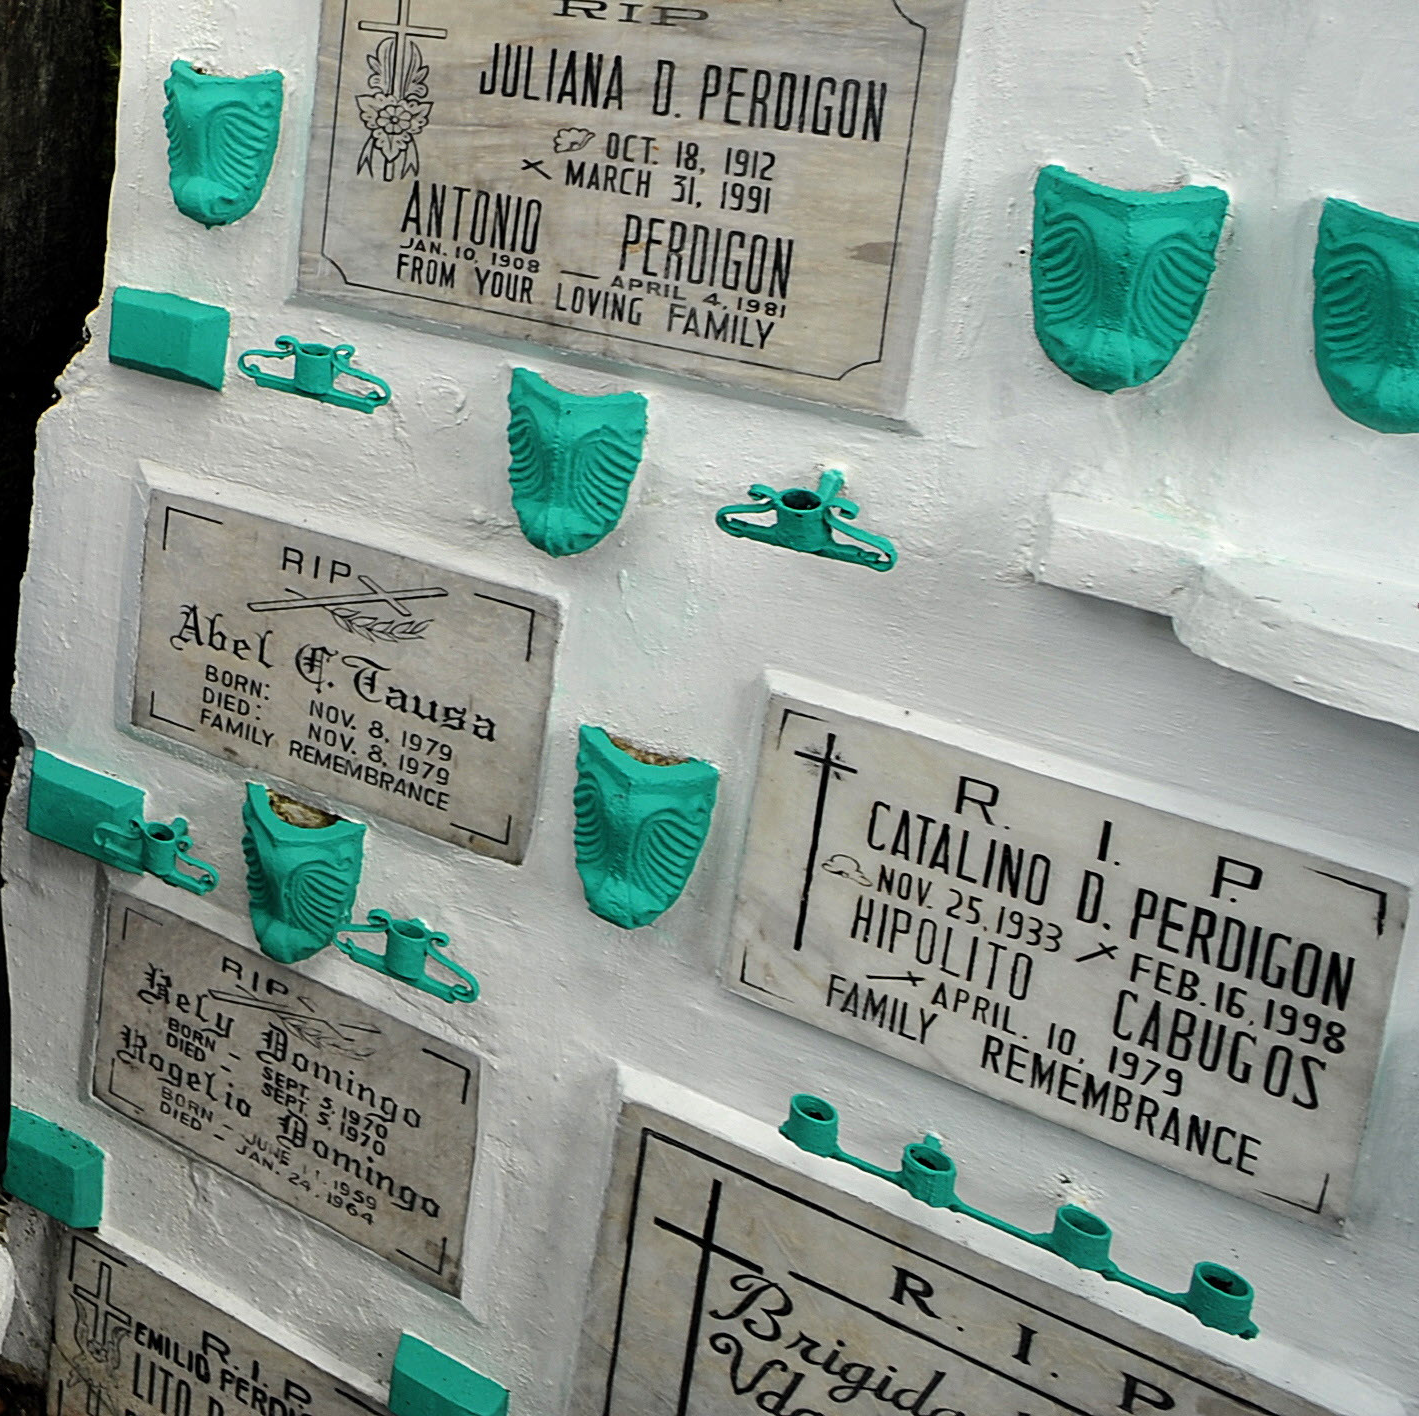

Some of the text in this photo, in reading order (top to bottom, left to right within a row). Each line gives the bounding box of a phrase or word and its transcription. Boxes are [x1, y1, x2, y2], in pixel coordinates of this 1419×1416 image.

[480, 43, 887, 142] JULIANA D. PERDIGON
[565, 160, 771, 214] MARCH 31, 1991
[606, 132, 776, 181] OCT. 18, 1912
[400, 239, 446, 257] JAN.
[455, 246, 478, 264] 10,
[491, 252, 539, 273] 1908
[611, 275, 687, 301] APRIL
[737, 297, 786, 318] 1981
[401, 181, 794, 299] ANTONIO PERDIGON
[396, 254, 774, 350] FROM YOUR LOVING FAMILY
[282, 546, 352, 584] RIP
[170, 605, 275, 668] Abel
[200, 709, 450, 811] FAMILY REMEMBRANCE
[202, 687, 262, 720] DIED:
[308, 724, 356, 753] NOV.
[399, 754, 450, 785] 1979
[205, 664, 271, 701] BORN:
[309, 700, 356, 729] NOV.
[402, 731, 453, 761] 1979
[954, 775, 1012, 832] R.
[1098, 819, 1122, 867] I.
[866, 800, 1357, 1013] CATALINO D. PERDIGON
[877, 864, 934, 910] NOV.
[222, 956, 289, 995] RIP
[849, 895, 1327, 1111] HIPOLITO CABUGOS
[168, 1017, 388, 1139] BORN SEPT. 1970
[256, 1022, 421, 1128] Domingo
[825, 974, 1263, 1176] FAMILY REMEMBRANCE
[931, 983, 1185, 1097] APRIL. 10, 1979
[116, 1024, 440, 1218] Rogelio Domingo
[166, 1033, 385, 1156] DIED SEPT. 1970
[160, 1101, 374, 1225] DIED JAN. 1964
[161, 1086, 377, 1210] BORN JUNE 1959
